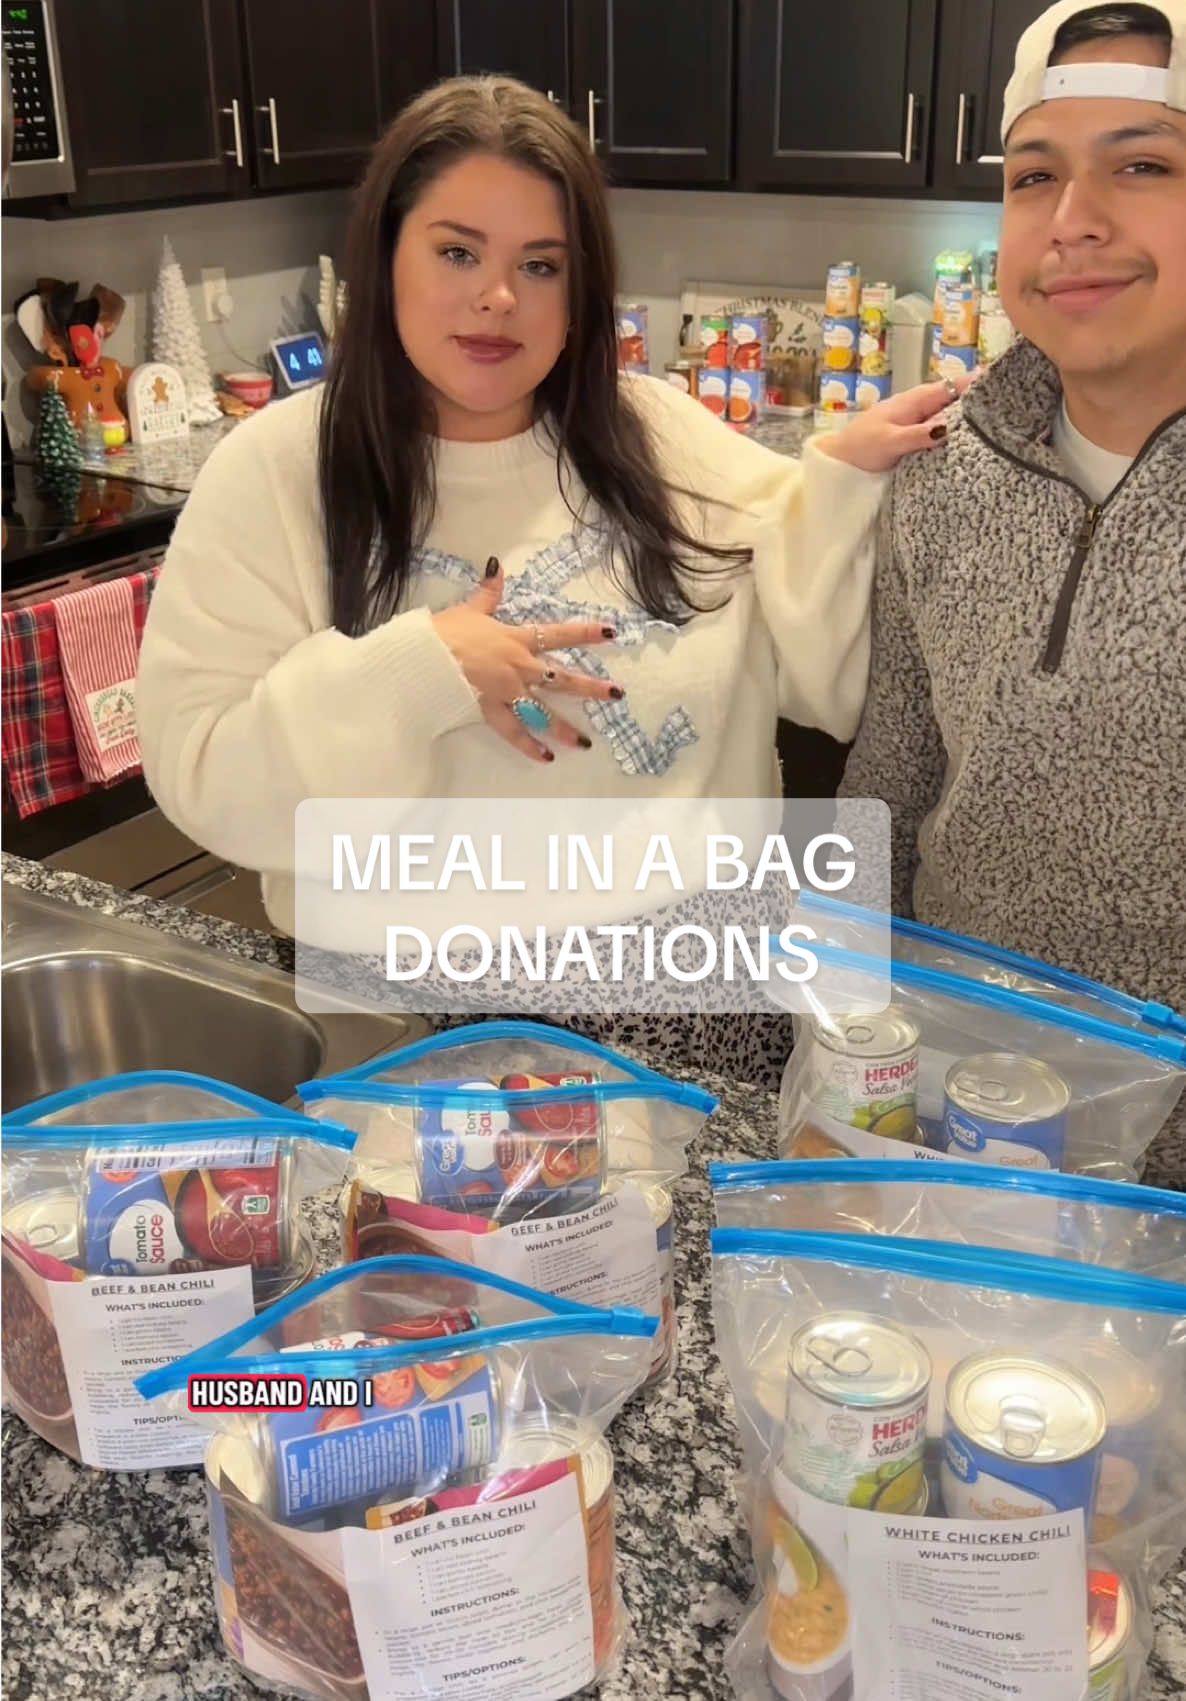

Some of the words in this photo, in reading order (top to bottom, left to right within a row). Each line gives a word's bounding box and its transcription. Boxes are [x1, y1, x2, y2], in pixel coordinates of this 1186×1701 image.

[864, 1057, 918, 1082] HERDE
[862, 1081, 897, 1096] Salsa
[557, 1213, 590, 1229] BEAN
[592, 1198, 619, 1217] CHILI
[135, 1214, 147, 1265] Tomato
[151, 1213, 165, 1265] Sauce
[525, 1237, 563, 1252] WHAT'S
[91, 1284, 124, 1297] BEEF
[128, 1285, 136, 1295] &
[141, 1281, 176, 1294] BEAN
[180, 1278, 215, 1290] CHILI
[550, 1271, 609, 1296] STRUCTIONS:
[105, 1301, 147, 1312] WHAT'S
[121, 1355, 184, 1366] INSTRUCTIO
[868, 1437, 912, 1458] Salsa
[394, 1523, 432, 1545] BEEF
[436, 1520, 446, 1531] &
[451, 1510, 493, 1527] BEAN
[497, 1499, 537, 1519] CHILI
[410, 1537, 459, 1558] WHAT'S
[461, 1523, 526, 1546] INCLUDED:
[884, 1525, 941, 1542] WHITE
[949, 1531, 1024, 1545] CHICKEN
[1029, 1524, 1072, 1541] CHILI
[917, 1549, 969, 1562] WHAT'S
[971, 1551, 1041, 1563] INCLUDED:
[430, 1586, 521, 1617] INSTRUCTIONS:
